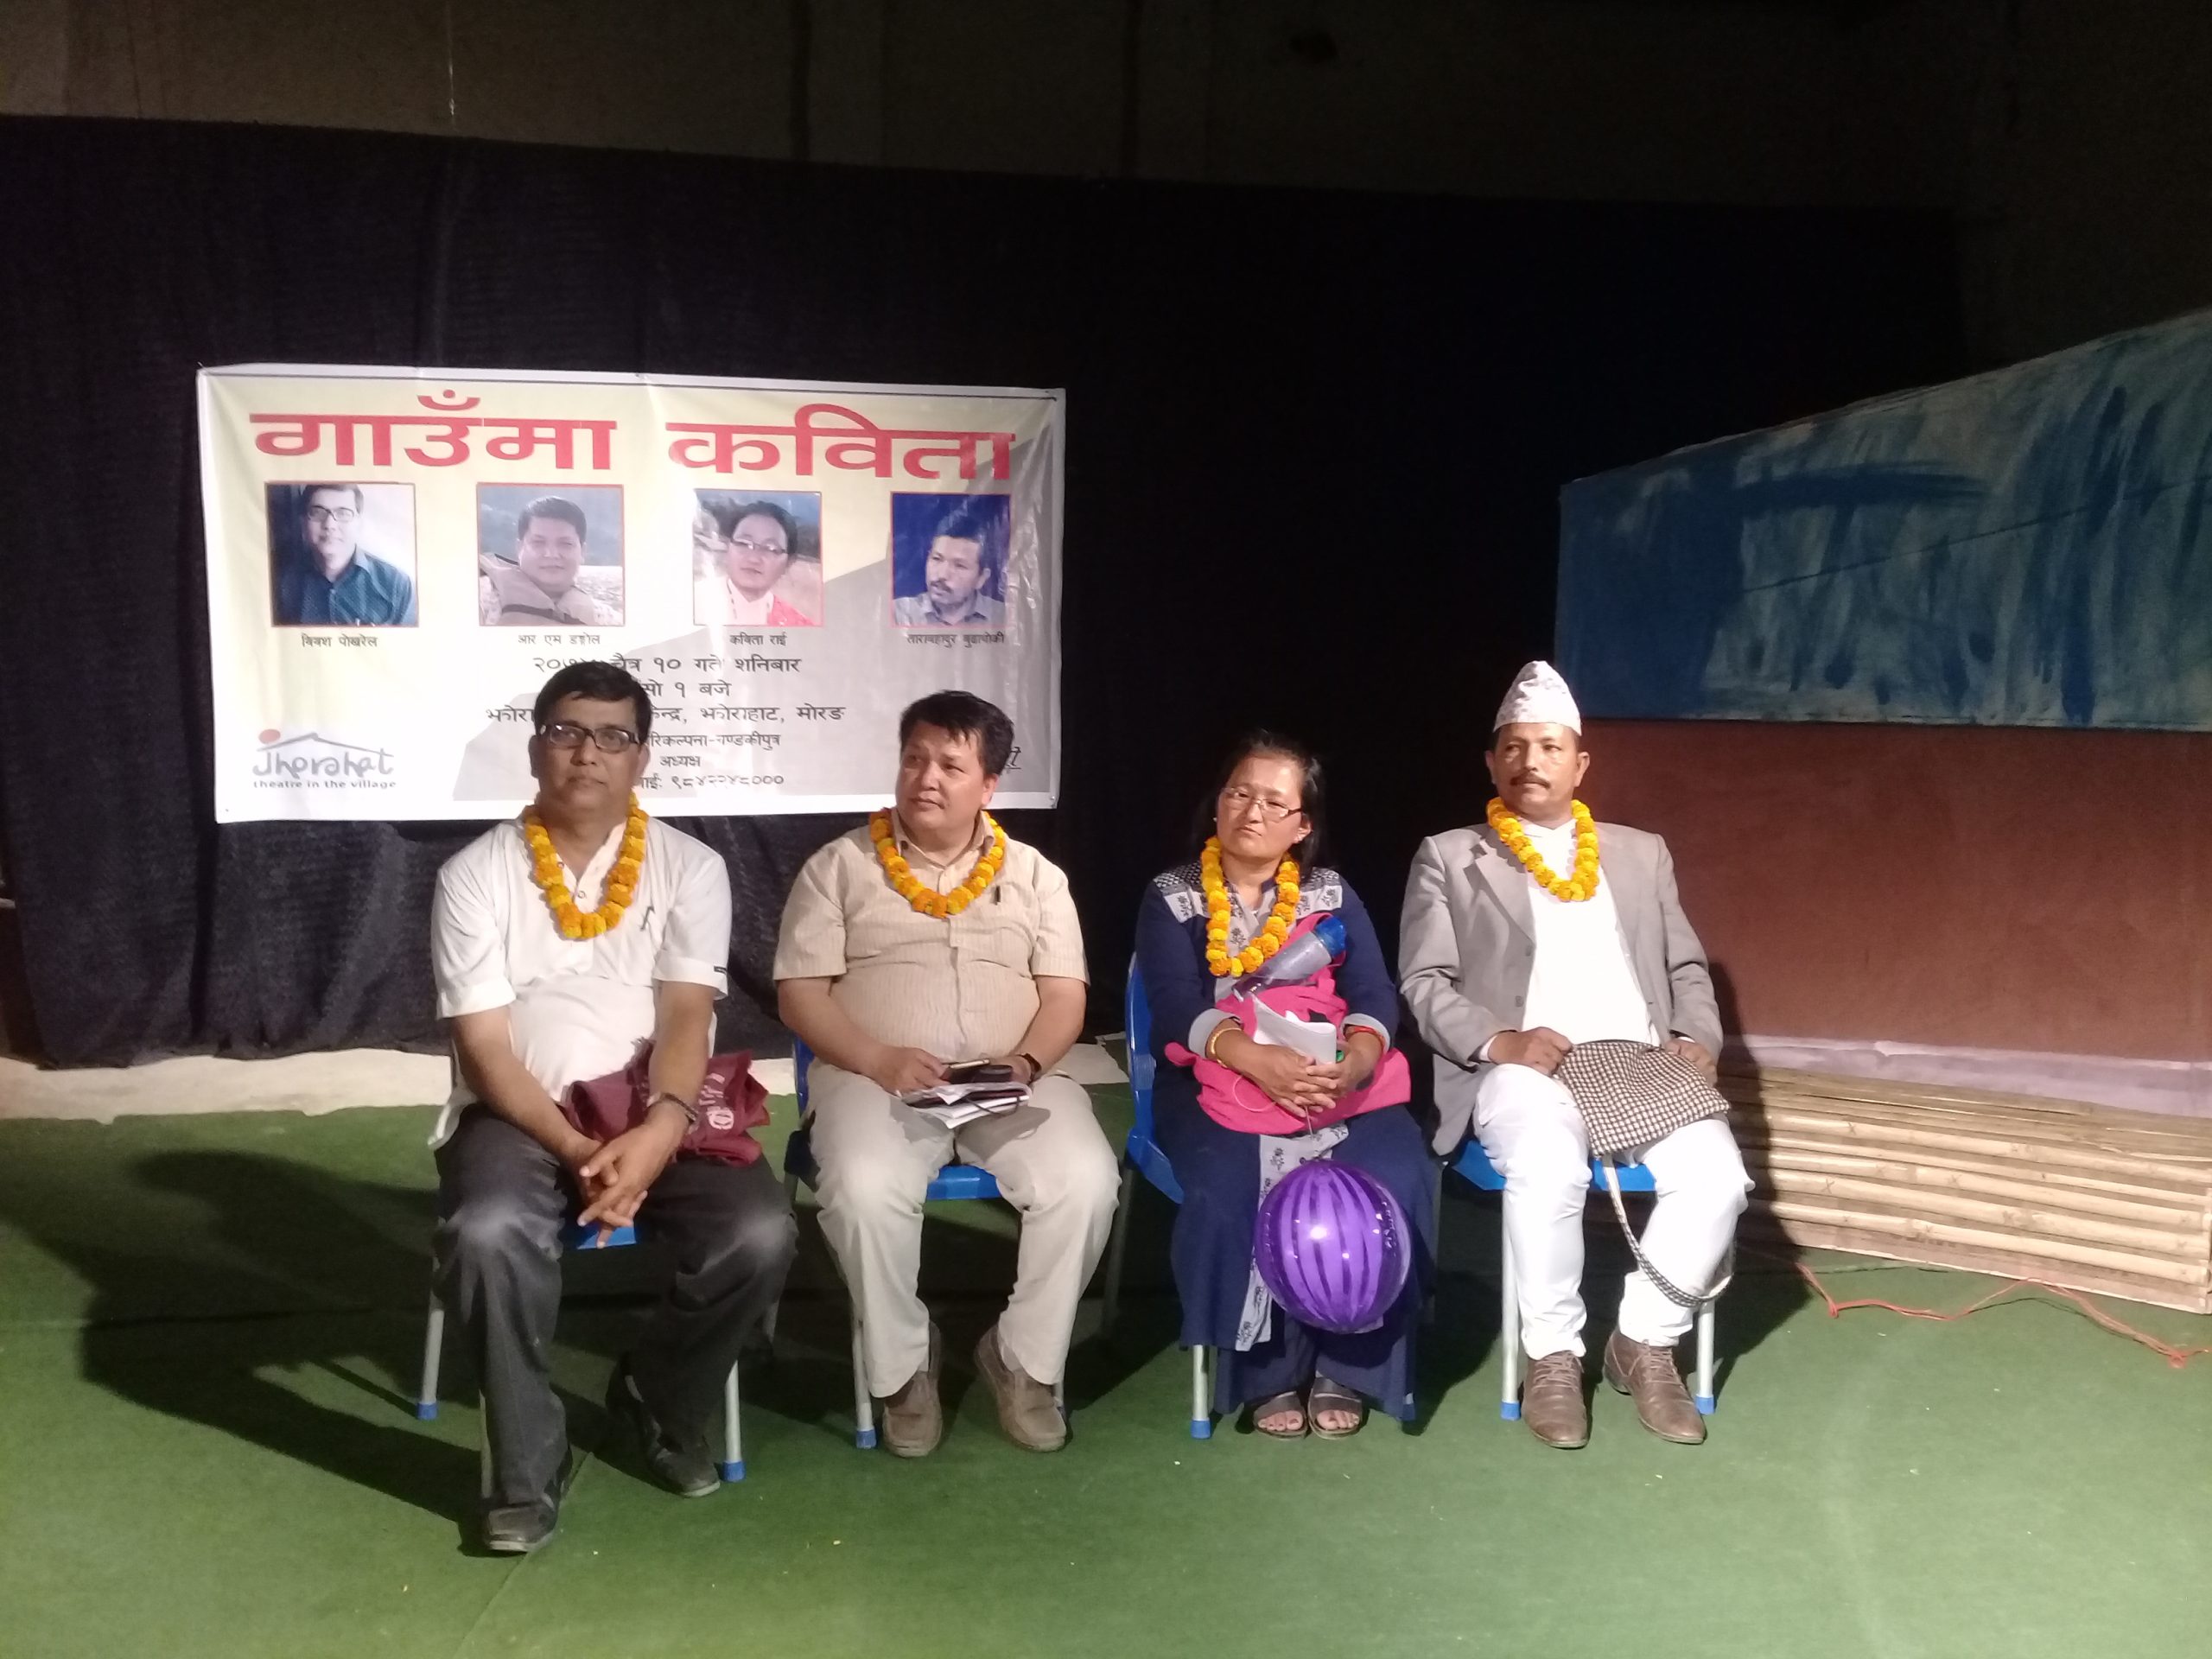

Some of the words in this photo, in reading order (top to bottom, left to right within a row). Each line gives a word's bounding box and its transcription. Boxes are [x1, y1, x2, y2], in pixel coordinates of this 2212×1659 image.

[250, 389, 618, 470] गाउँमा
[665, 403, 1016, 480] कविता
[769, 631, 788, 646] राई
[653, 657, 682, 674] १०
[694, 654, 724, 672] गते
[734, 653, 802, 672] शनिबार
[674, 681, 686, 698] १
[698, 679, 733, 697] बजे
[795, 702, 847, 721] मोरङ
[251, 747, 395, 780] Jhorahat
[660, 755, 702, 768] अध्यक्ष
[253, 780, 303, 789] theatre
[307, 780, 320, 789] in
[324, 780, 346, 789] the
[351, 780, 397, 790] village
